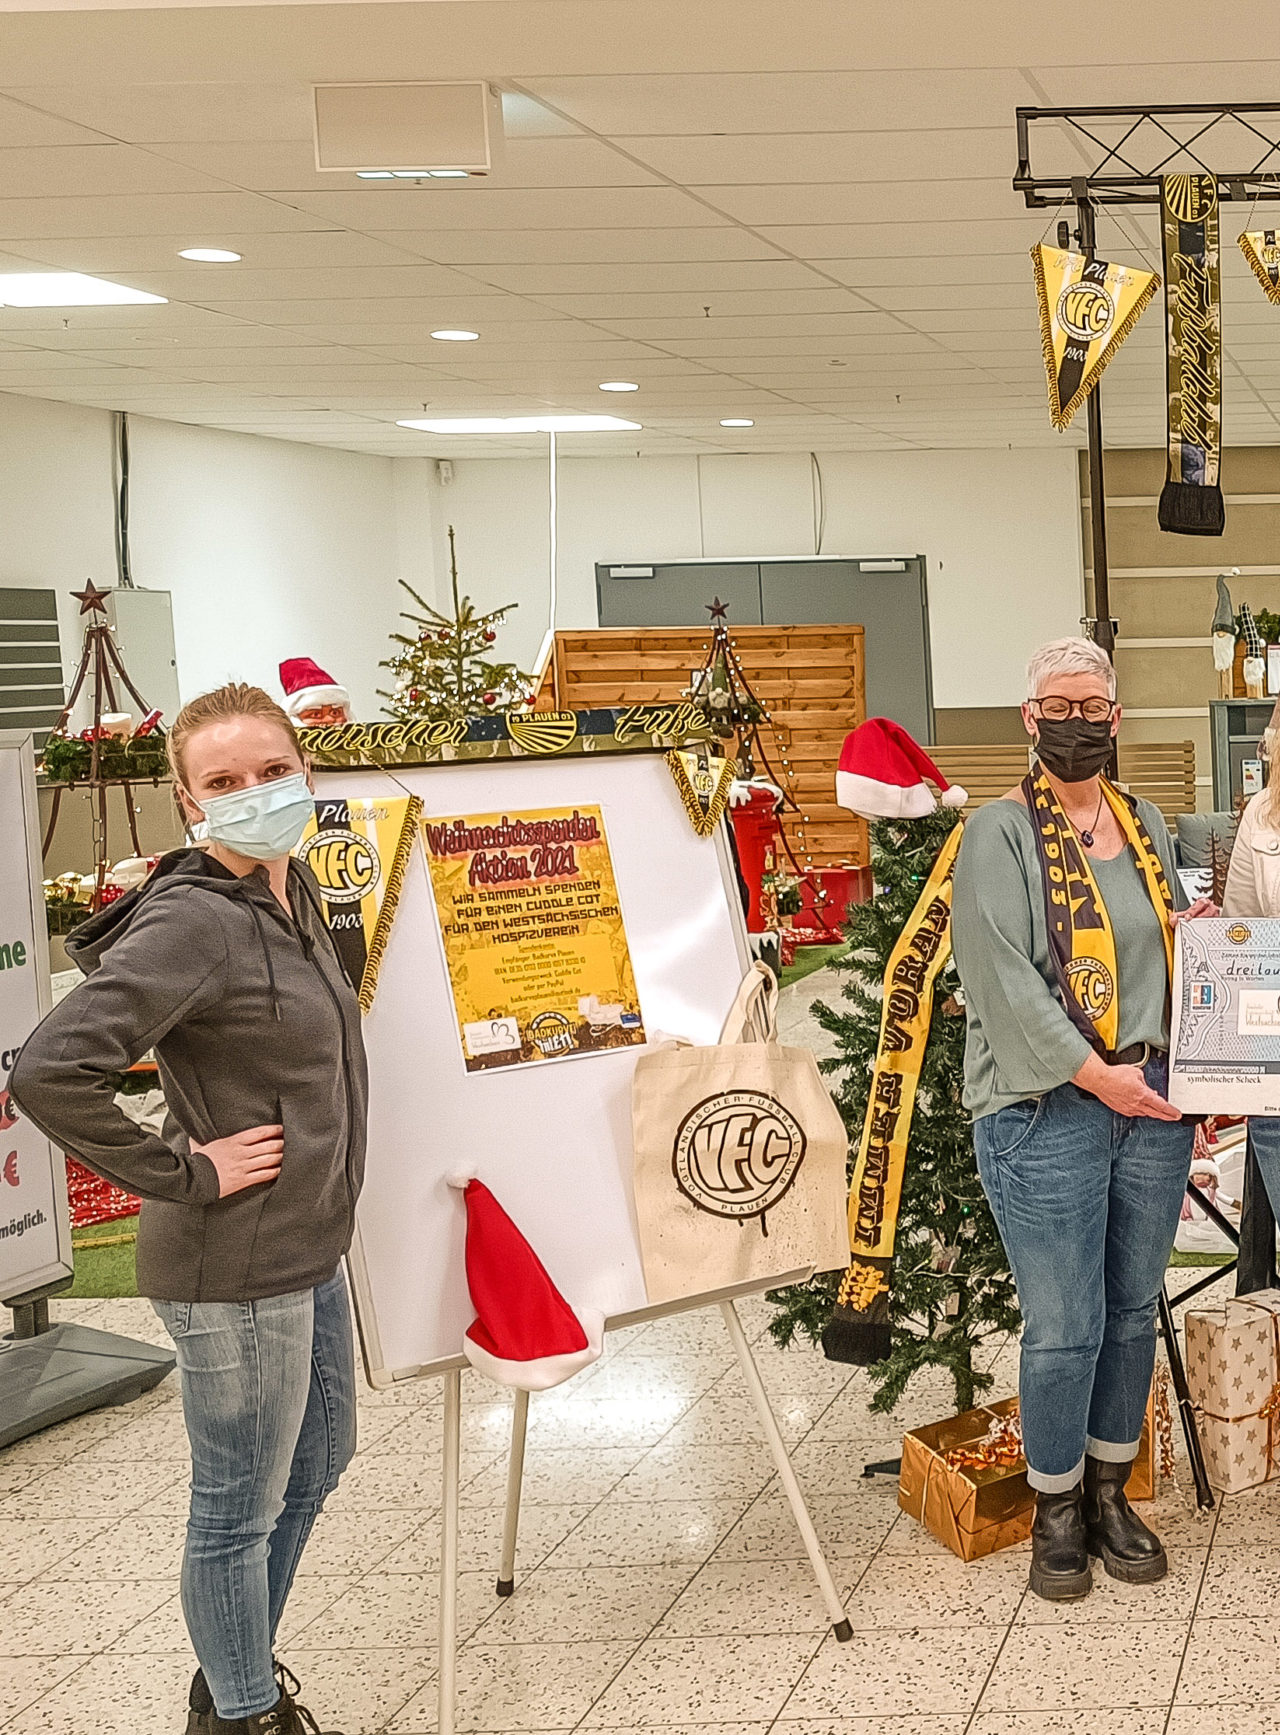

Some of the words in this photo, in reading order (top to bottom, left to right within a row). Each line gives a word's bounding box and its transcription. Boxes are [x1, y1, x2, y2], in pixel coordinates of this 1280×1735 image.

[1065, 291, 1110, 333] VFC
[522, 711, 560, 723] PLAUEN
[318, 803, 389, 824] Plauen
[307, 841, 374, 890] VFC
[468, 849, 532, 888] Aktion
[530, 844, 580, 879] 2021
[479, 886, 541, 903] SAMMELN
[545, 879, 601, 895] SPENDEN
[457, 906, 482, 919] FÜR
[526, 897, 574, 911] CUDDLE
[577, 894, 601, 905] COT
[329, 913, 364, 931] 1903
[444, 922, 470, 936] FÜR
[473, 919, 500, 933] DEN
[853, 1071, 905, 1250] IMMER
[880, 895, 952, 1056] VORAN
[1187, 1074, 1234, 1084] symbolischer
[1236, 1075, 1262, 1084] Scheck
[748, 1096, 801, 1146] FUSSBALL
[779, 1151, 800, 1185] CLUB
[692, 1112, 792, 1194] VFC
[720, 1196, 769, 1213] PLAUEN
